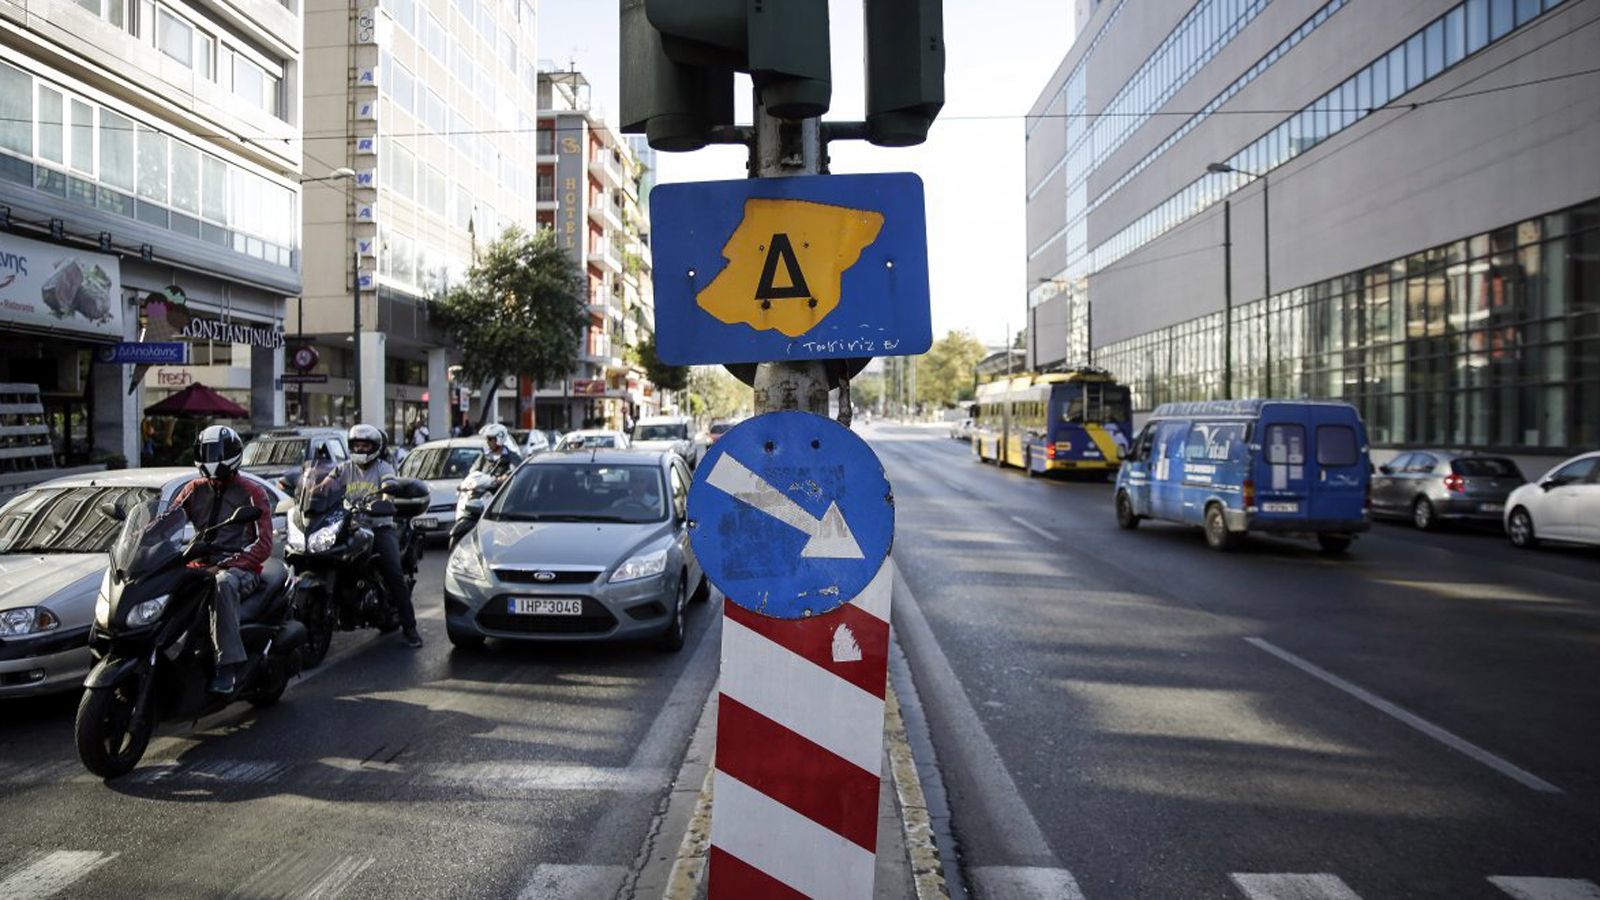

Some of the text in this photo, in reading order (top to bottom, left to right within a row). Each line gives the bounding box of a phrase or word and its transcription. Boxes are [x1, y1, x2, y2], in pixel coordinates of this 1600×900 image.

[357, 71, 373, 287] AIRWAYS
[563, 177, 577, 250] HOTEL
[0, 251, 28, 276] νης
[157, 368, 192, 385] fresh
